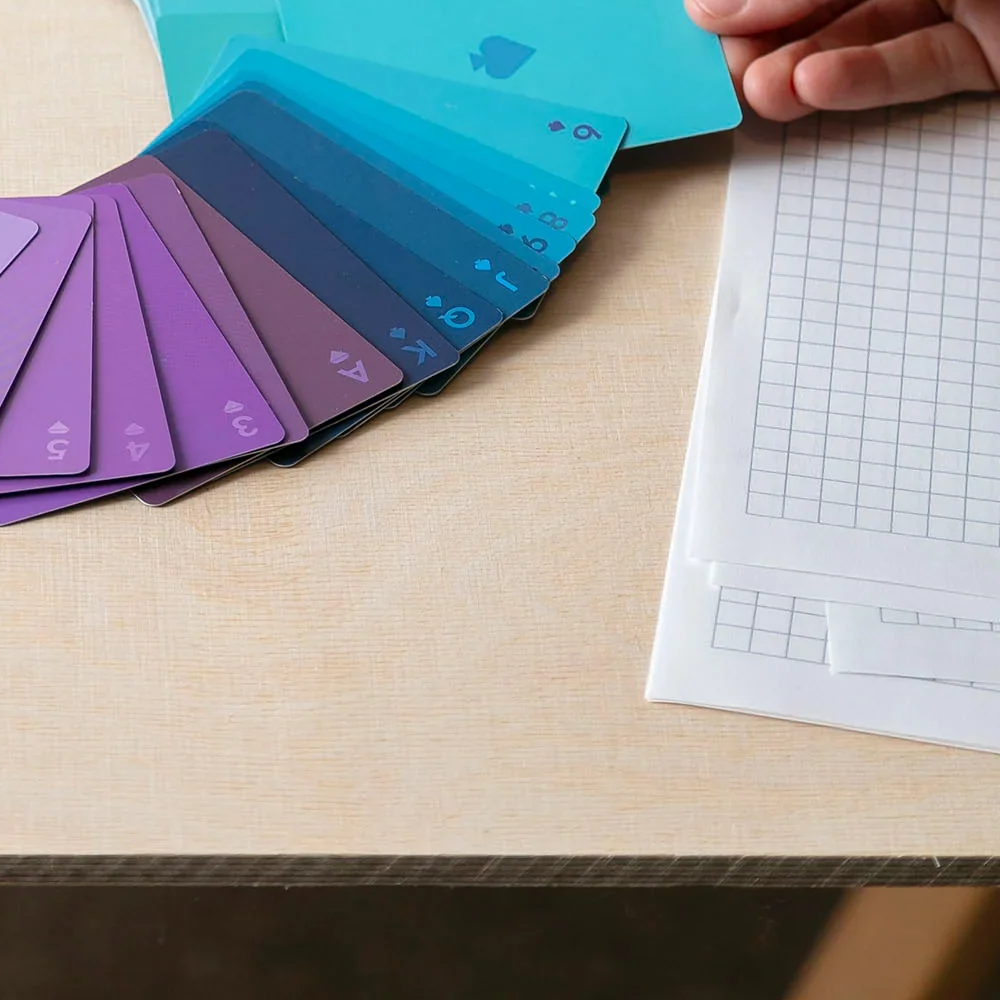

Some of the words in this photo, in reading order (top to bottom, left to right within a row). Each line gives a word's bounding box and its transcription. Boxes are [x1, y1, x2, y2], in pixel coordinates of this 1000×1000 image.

[573, 124, 602, 141] 6
[538, 211, 568, 230] 8
[496, 271, 518, 292] J
[438, 306, 476, 329] Q
[401, 338, 438, 366] K
[337, 359, 369, 383] A
[231, 415, 259, 437] 3
[46, 439, 71, 461] 5
[125, 441, 150, 463] 4
